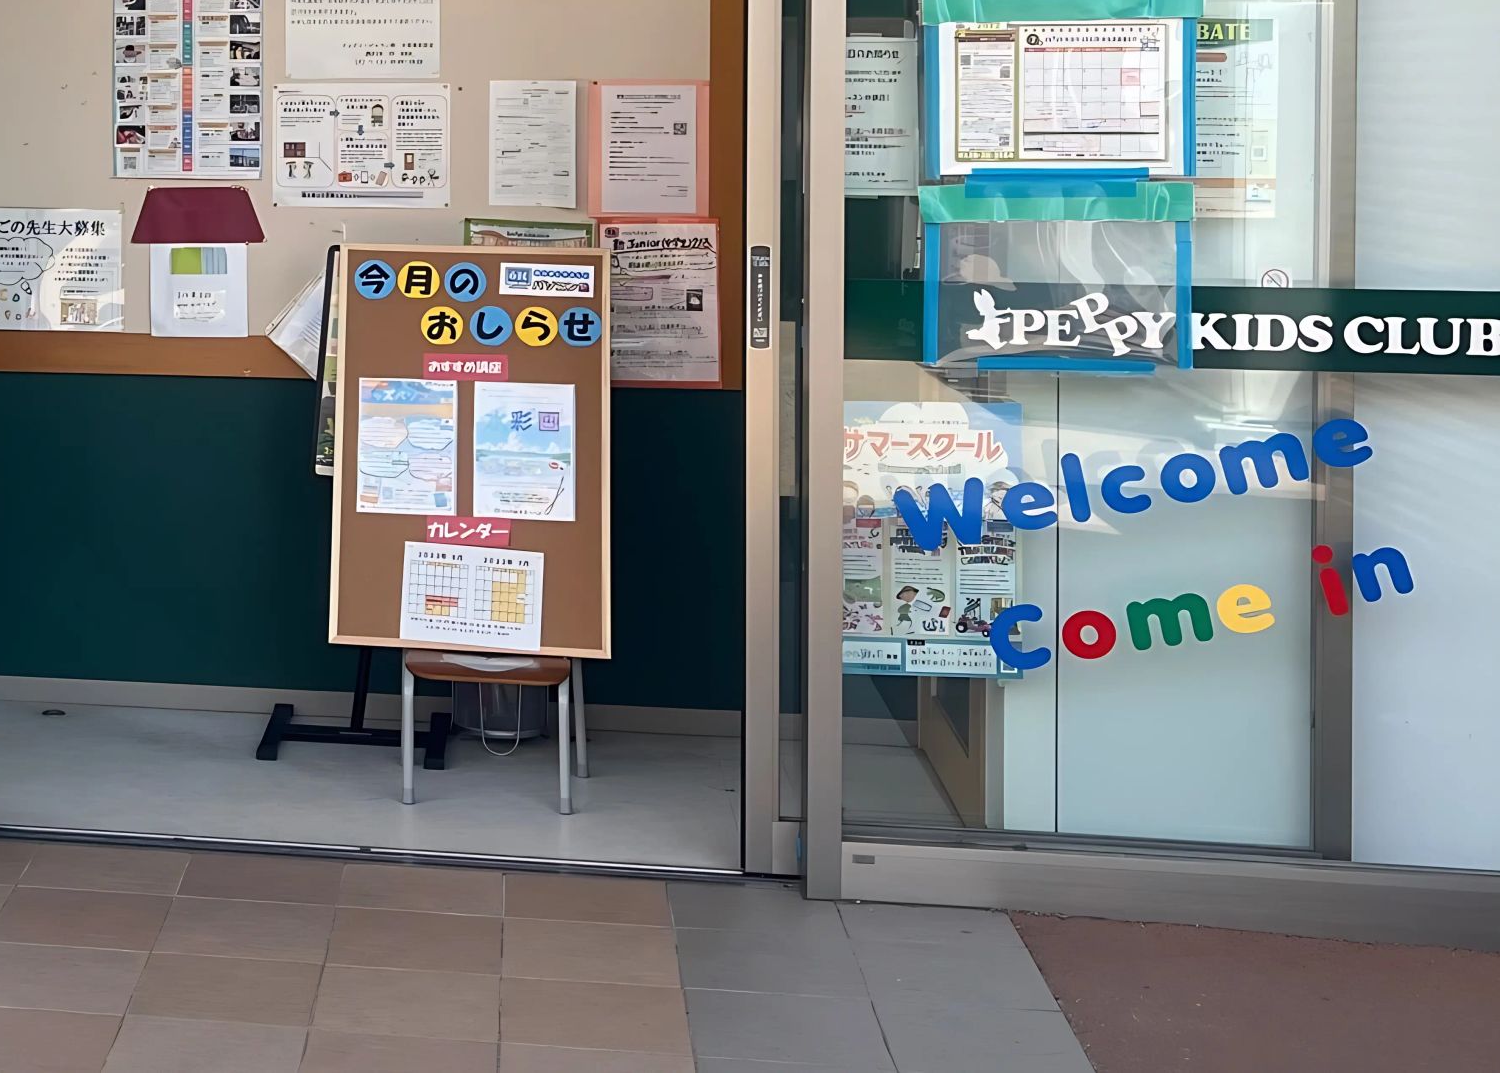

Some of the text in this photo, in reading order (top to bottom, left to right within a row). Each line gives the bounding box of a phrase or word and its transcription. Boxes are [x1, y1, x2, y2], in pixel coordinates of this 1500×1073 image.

[358, 263, 479, 297] 今月の
[426, 309, 595, 343] おしらせ
[1005, 291, 1500, 356] PEPPY KIDS CLUB
[843, 429, 1004, 463] サマースクール
[893, 417, 1374, 553] Welcome
[427, 522, 509, 539] カレンダー
[989, 544, 1415, 671] Come in
